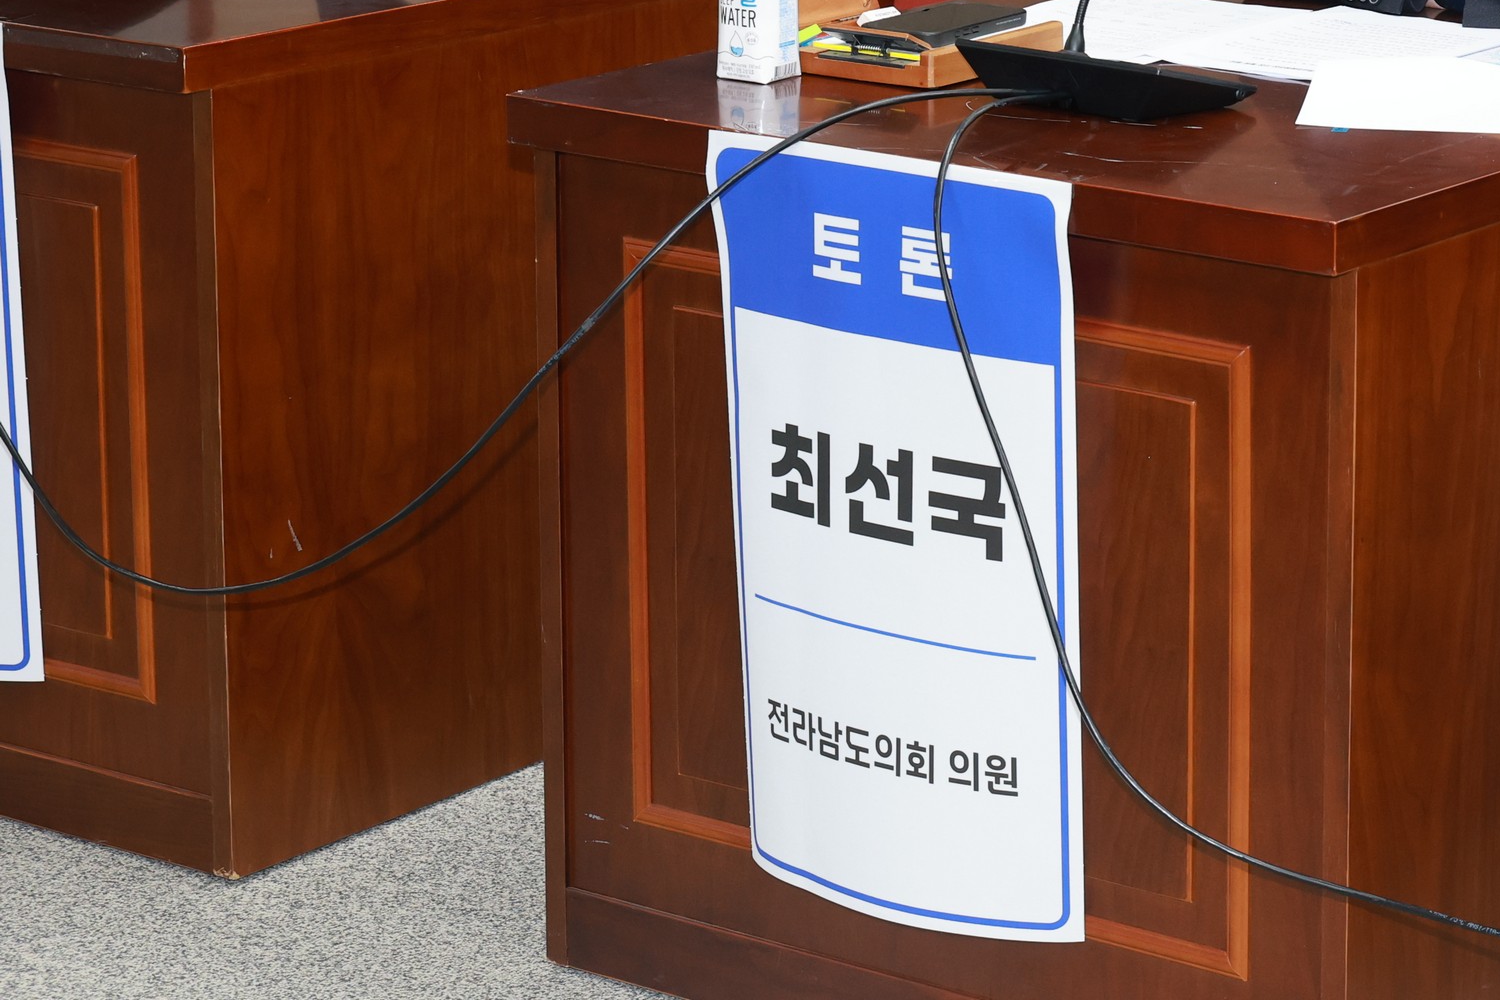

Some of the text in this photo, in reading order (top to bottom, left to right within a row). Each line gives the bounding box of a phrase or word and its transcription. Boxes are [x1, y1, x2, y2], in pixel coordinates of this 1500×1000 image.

[720, 6, 756, 28] WATER
[770, 422, 1006, 562] 최선국
[767, 698, 1019, 797] 전라남도의회 의원
